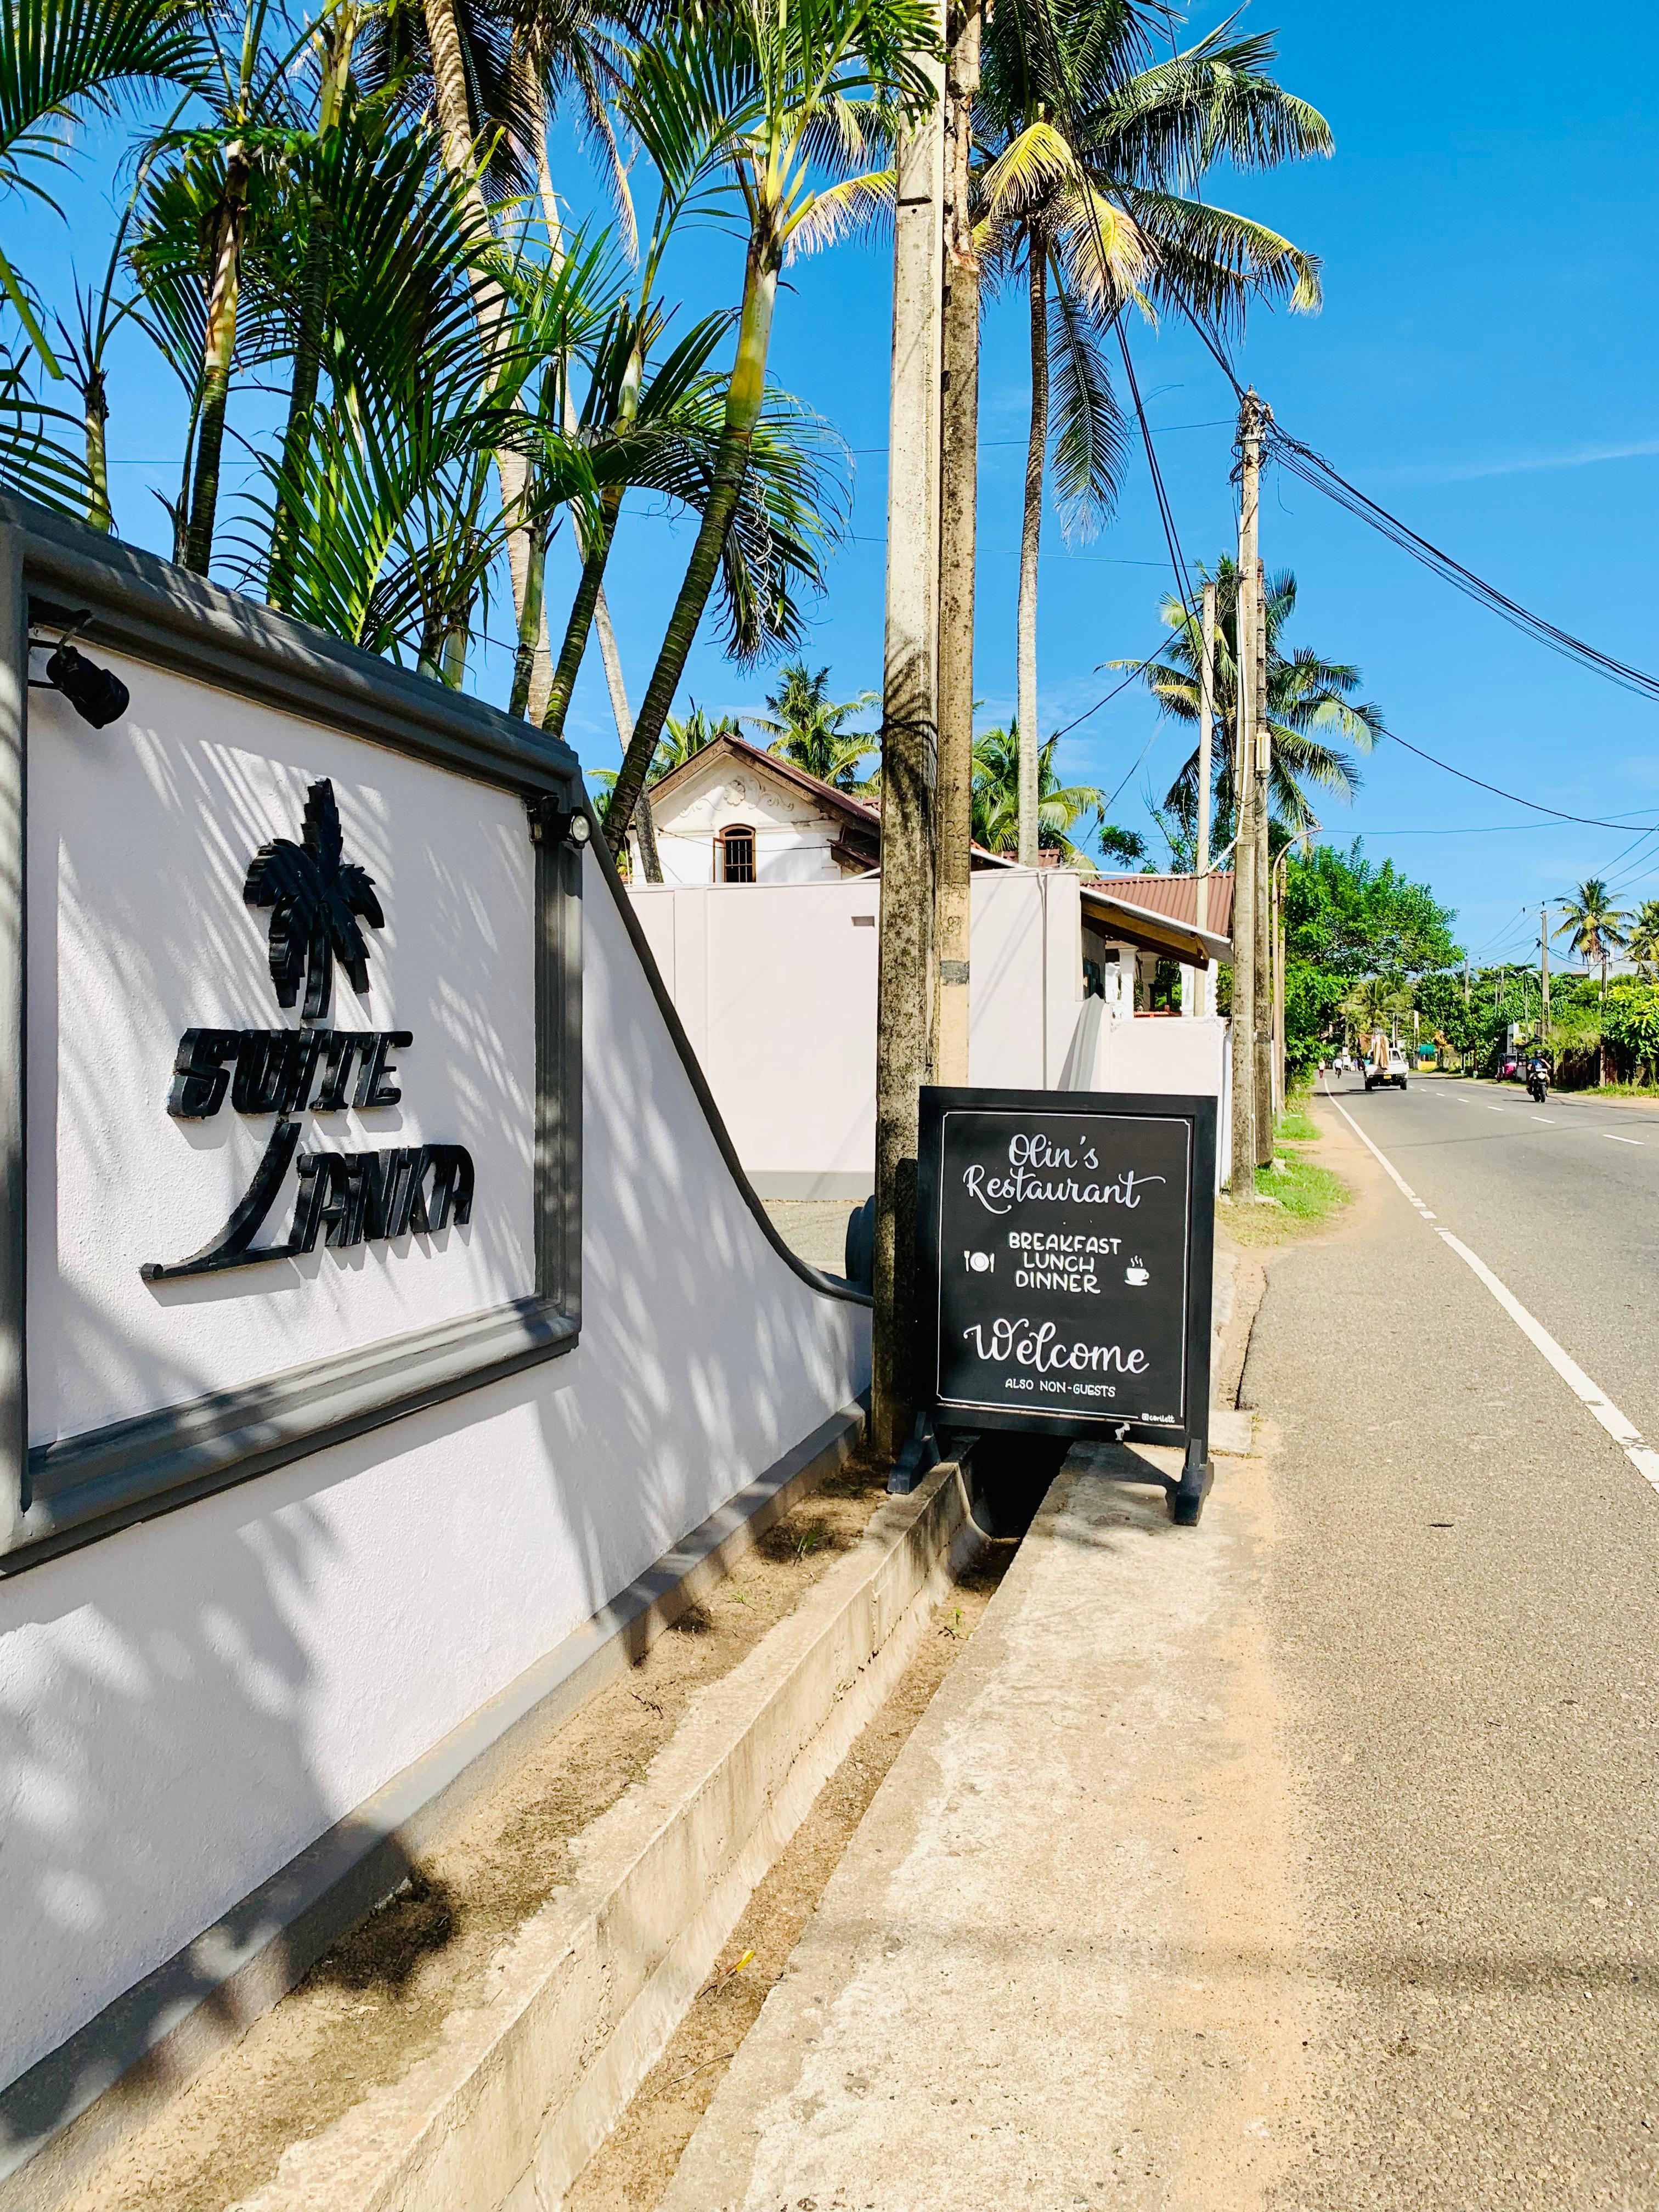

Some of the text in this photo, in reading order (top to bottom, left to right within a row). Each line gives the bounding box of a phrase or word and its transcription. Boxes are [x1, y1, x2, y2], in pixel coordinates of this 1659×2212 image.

[166, 1028, 413, 1119] SUITE
[1008, 1133, 1099, 1170] Olin's
[139, 1116, 475, 1280] LANKA
[962, 1165, 1166, 1215] Restaurant
[1009, 1232, 1122, 1255] BREAKFAST
[1023, 1251, 1094, 1273] LUNCH
[1015, 1270, 1101, 1294] DINNER
[963, 1318, 1150, 1374] Welcome
[1005, 1378, 1116, 1397] ALSO NON-GUESTS
